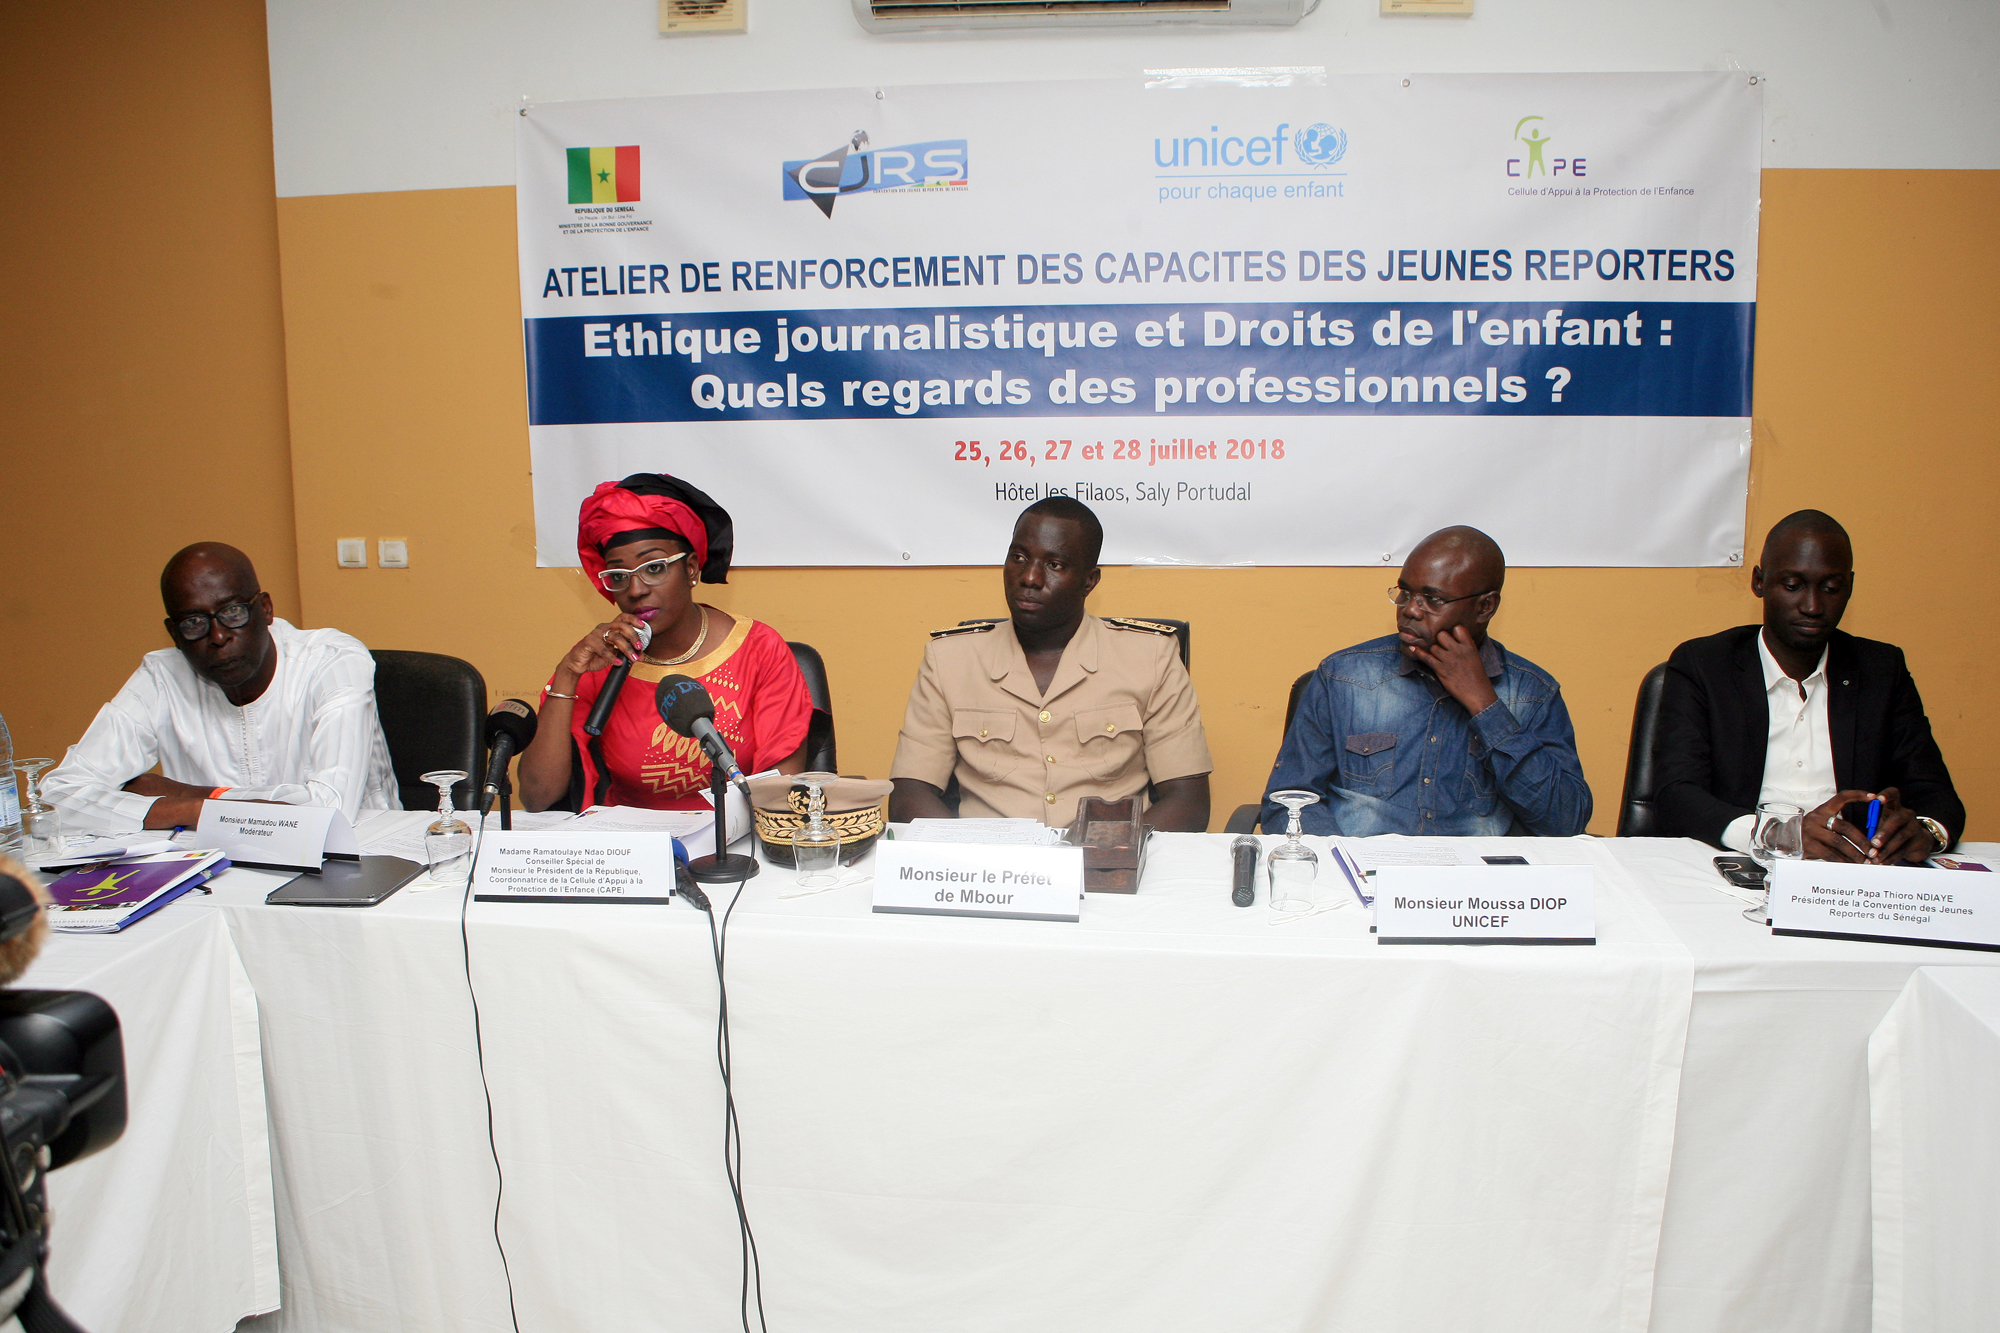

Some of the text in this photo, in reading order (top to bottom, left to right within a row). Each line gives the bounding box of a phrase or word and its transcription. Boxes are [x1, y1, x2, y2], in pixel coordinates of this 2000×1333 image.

[1154, 123, 1289, 167] unicef
[798, 149, 964, 194] CJRS
[1159, 181, 1344, 203] pour chaque enfant
[1508, 186, 1695, 198] Cellule d'Appui à la Protection de l'Enfance
[542, 249, 1735, 298] ATELIER DE RENFORCEMENT DES CAPACITES DES JEUNES REPORTERS
[583, 320, 761, 363] Ethique
[775, 314, 1117, 362] journalistique
[1135, 311, 1185, 348] et
[1203, 310, 1354, 347] Droits
[1372, 310, 1434, 346] de
[1452, 309, 1642, 346] l'enfant
[691, 366, 1572, 415] Quels regards des professionnels ?
[954, 438, 1286, 467] 25, 26, 27 et 28 juillet 2018
[995, 481, 1251, 506] Hôtel les Filaos, Saly Portudal
[219, 816, 299, 828] Monsieur Mamadou WANE
[533, 848, 582, 857] Ramatoulaye
[566, 858, 594, 866] Spécial
[595, 868, 641, 876] République,
[899, 866, 1052, 885] Monsieur le Préfet
[598, 877, 627, 885] d'Appui
[934, 888, 1014, 904] de Mbour
[1811, 886, 1954, 902] Monsieur Papa Thioro NDIAYE
[1394, 896, 1568, 910] Monsieur Moussa DIOP
[1791, 895, 1835, 905] Président
[1863, 900, 1916, 911] Convention
[1919, 904, 1936, 912] des
[1939, 906, 1973, 915] Jeunes
[1452, 915, 1510, 928] UNICEF
[1829, 908, 1931, 924] Reporters du Sénégal
